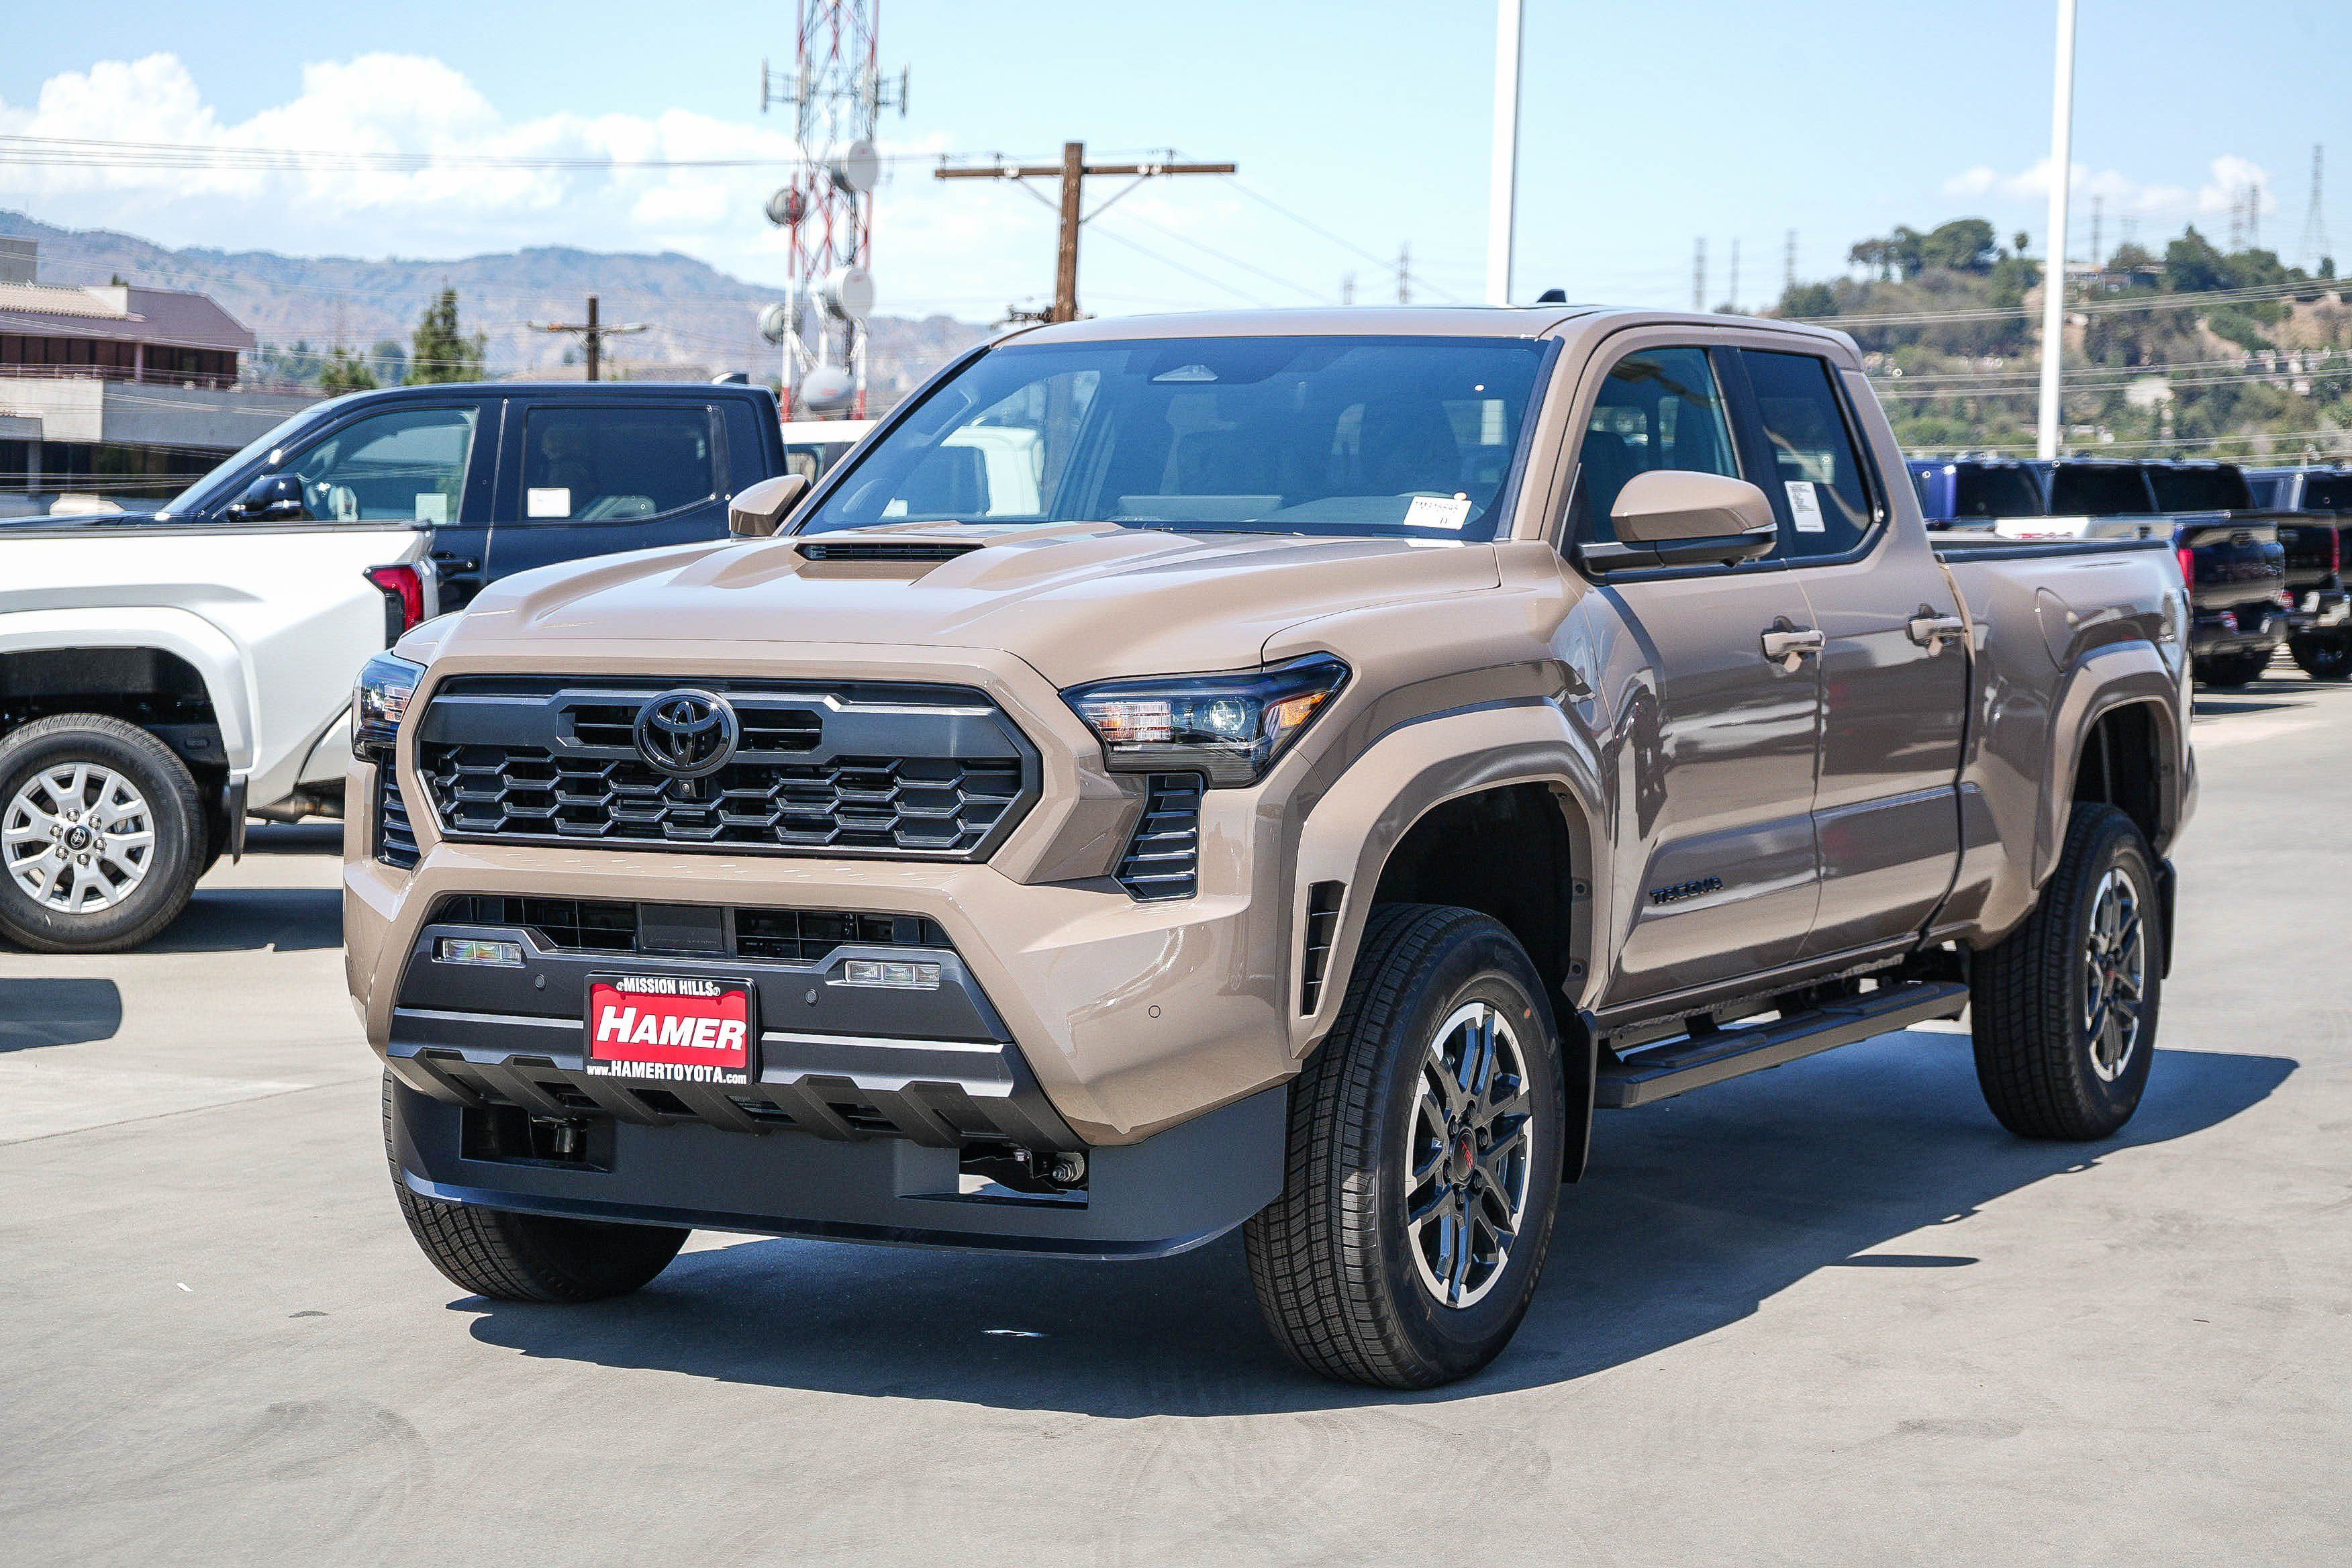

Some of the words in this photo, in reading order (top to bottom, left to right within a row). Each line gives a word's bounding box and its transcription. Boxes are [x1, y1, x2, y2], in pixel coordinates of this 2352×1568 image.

[1649, 875, 1724, 905] TACOMA
[623, 977, 676, 995] MISSION
[679, 980, 714, 997] HILLS
[596, 1005, 747, 1050] HAMER
[586, 1060, 747, 1085] www.HAMERTOYOTA.com
